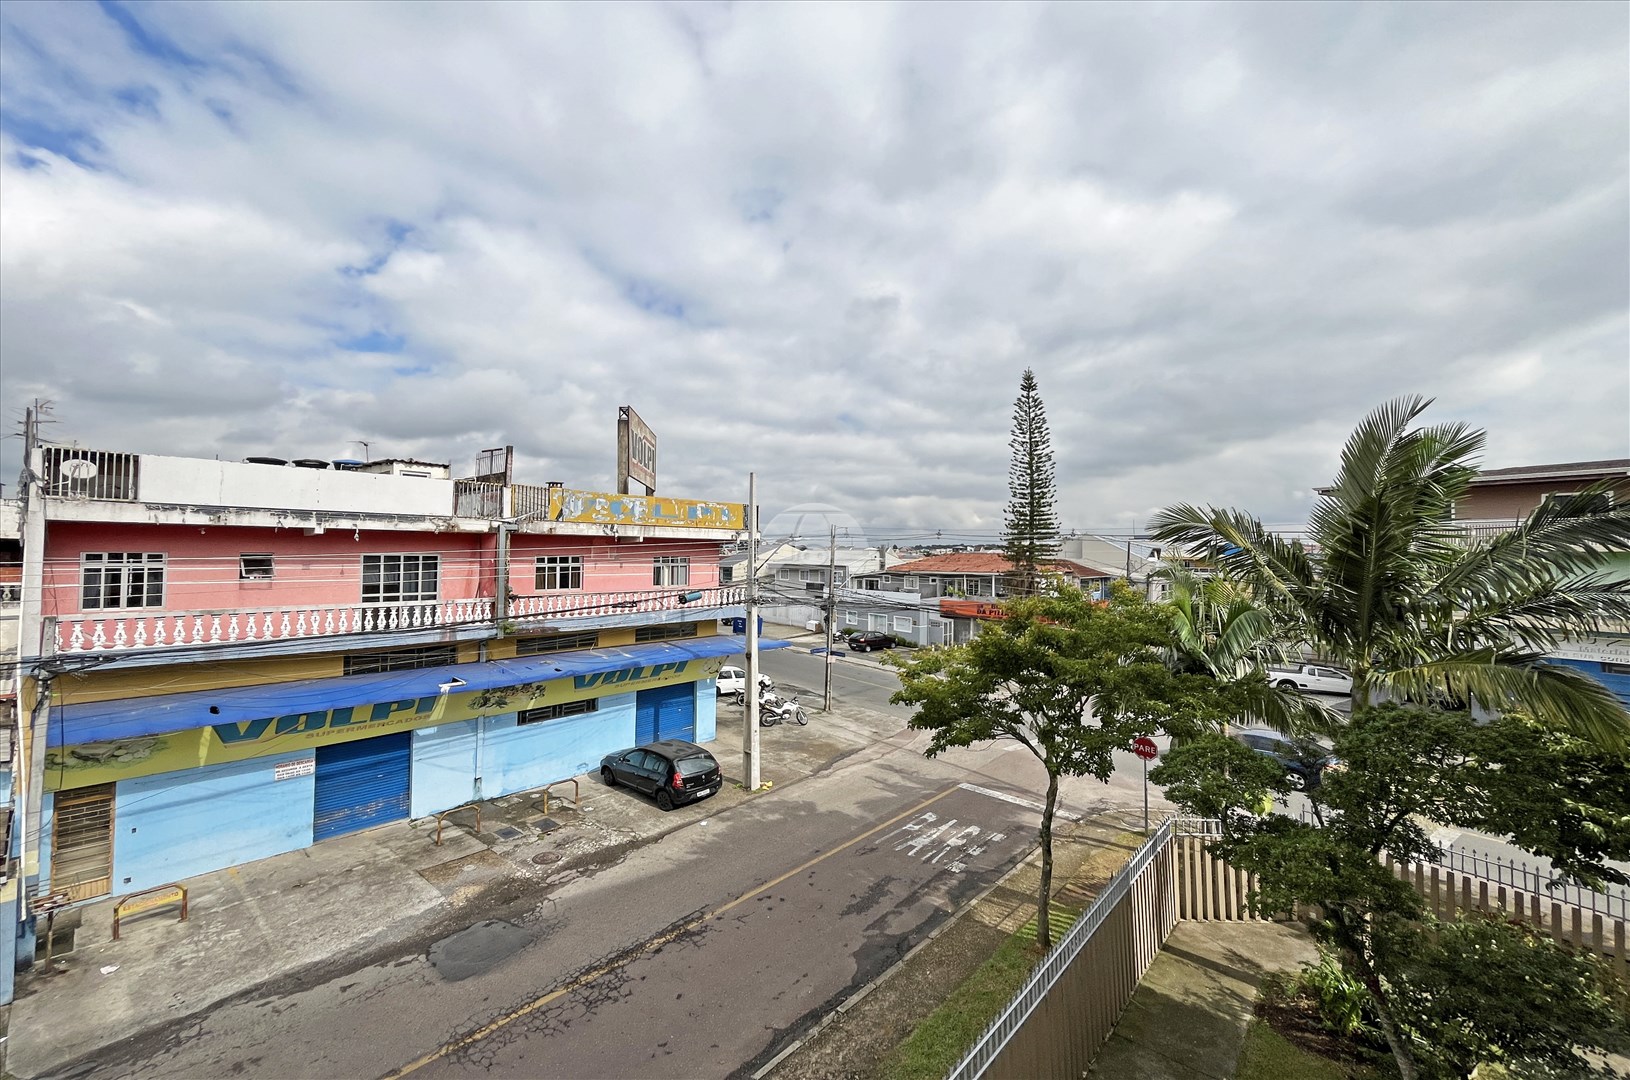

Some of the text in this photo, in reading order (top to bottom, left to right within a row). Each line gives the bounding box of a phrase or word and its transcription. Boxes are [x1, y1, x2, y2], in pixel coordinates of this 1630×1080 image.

[631, 429, 655, 474] VOLPI
[574, 660, 689, 690] VOLPI
[212, 694, 437, 744] VOLPI
[304, 714, 431, 740] SUPERMERCADOS
[1133, 743, 1156, 754] PARE
